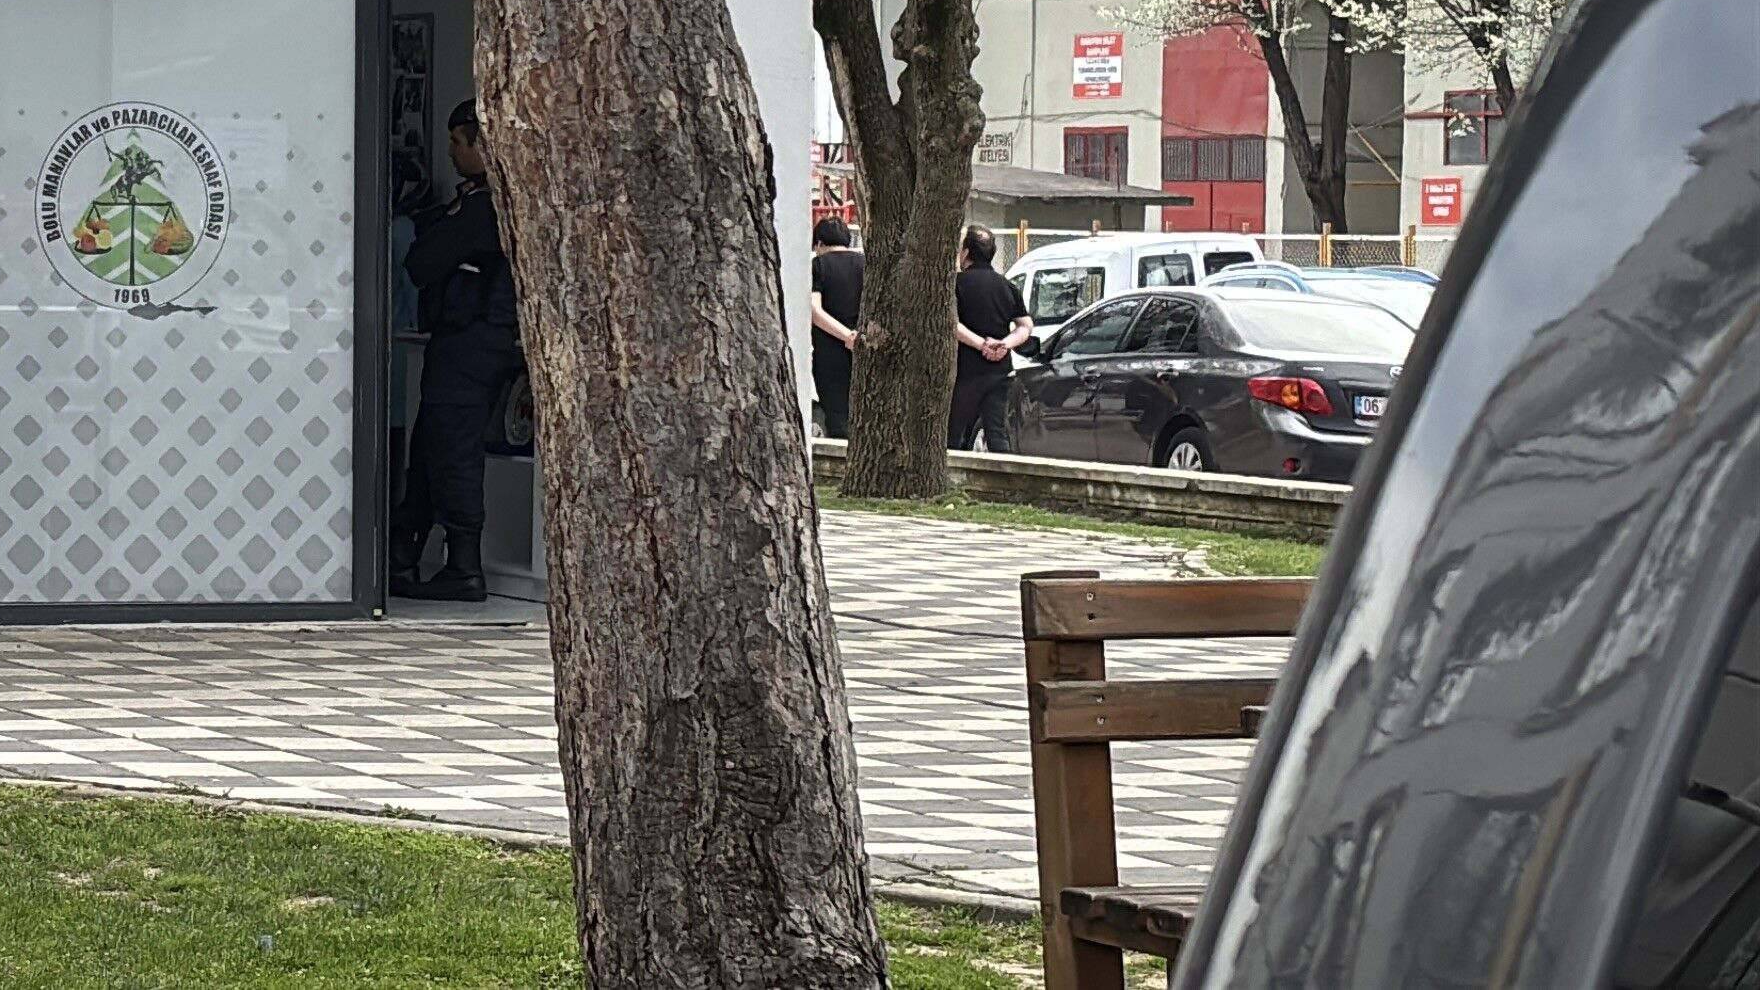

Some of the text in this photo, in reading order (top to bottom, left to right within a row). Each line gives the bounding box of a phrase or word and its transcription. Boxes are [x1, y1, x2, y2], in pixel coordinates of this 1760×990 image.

[41, 108, 225, 243] BOLU MANAVLAR ve PAZARCILAR ESNAF ODASI
[114, 288, 151, 304] 1969
